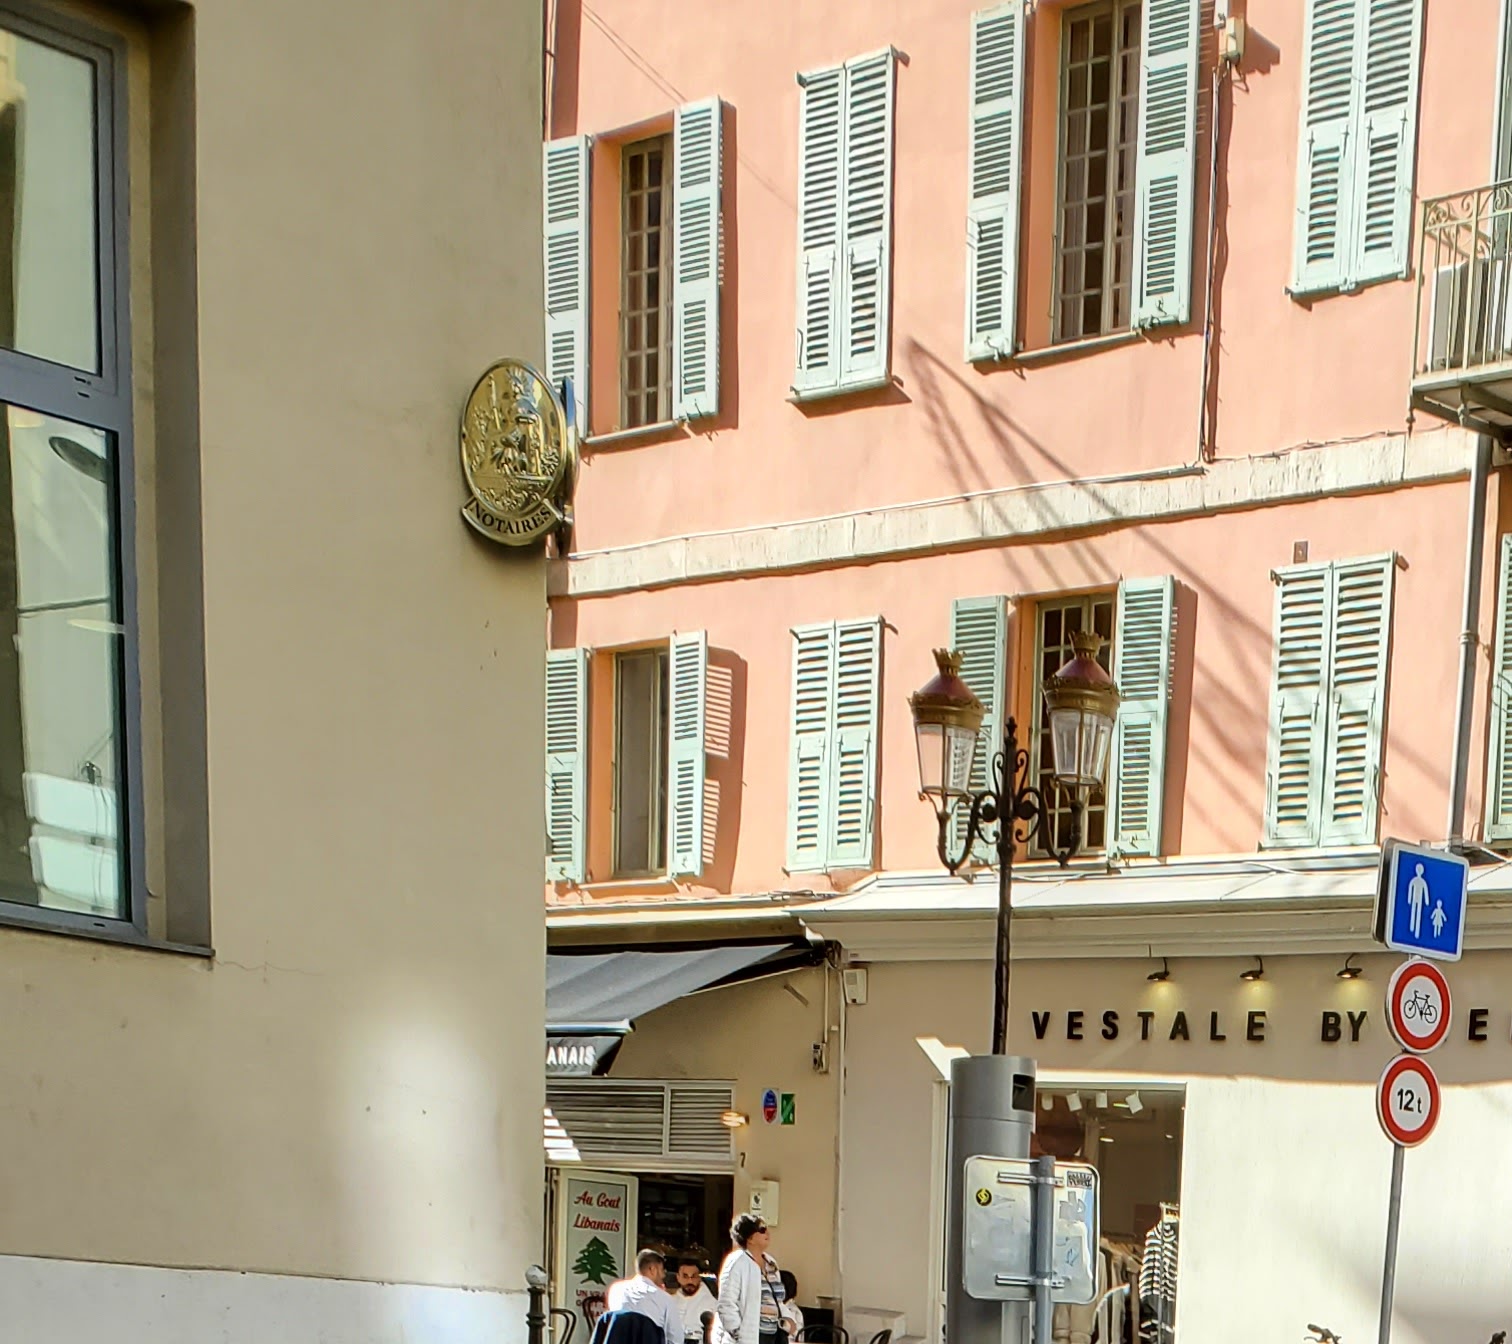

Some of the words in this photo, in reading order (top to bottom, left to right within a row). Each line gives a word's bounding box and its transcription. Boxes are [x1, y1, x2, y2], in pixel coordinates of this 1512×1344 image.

[470, 501, 551, 534] NOTAIRES
[1031, 1010, 1267, 1042] VESTALE
[1320, 1010, 1368, 1042] BY
[546, 1046, 596, 1067] ANAIS
[740, 1152, 746, 1168] 7
[574, 1190, 593, 1206] Au
[572, 1213, 621, 1232] Libanais
